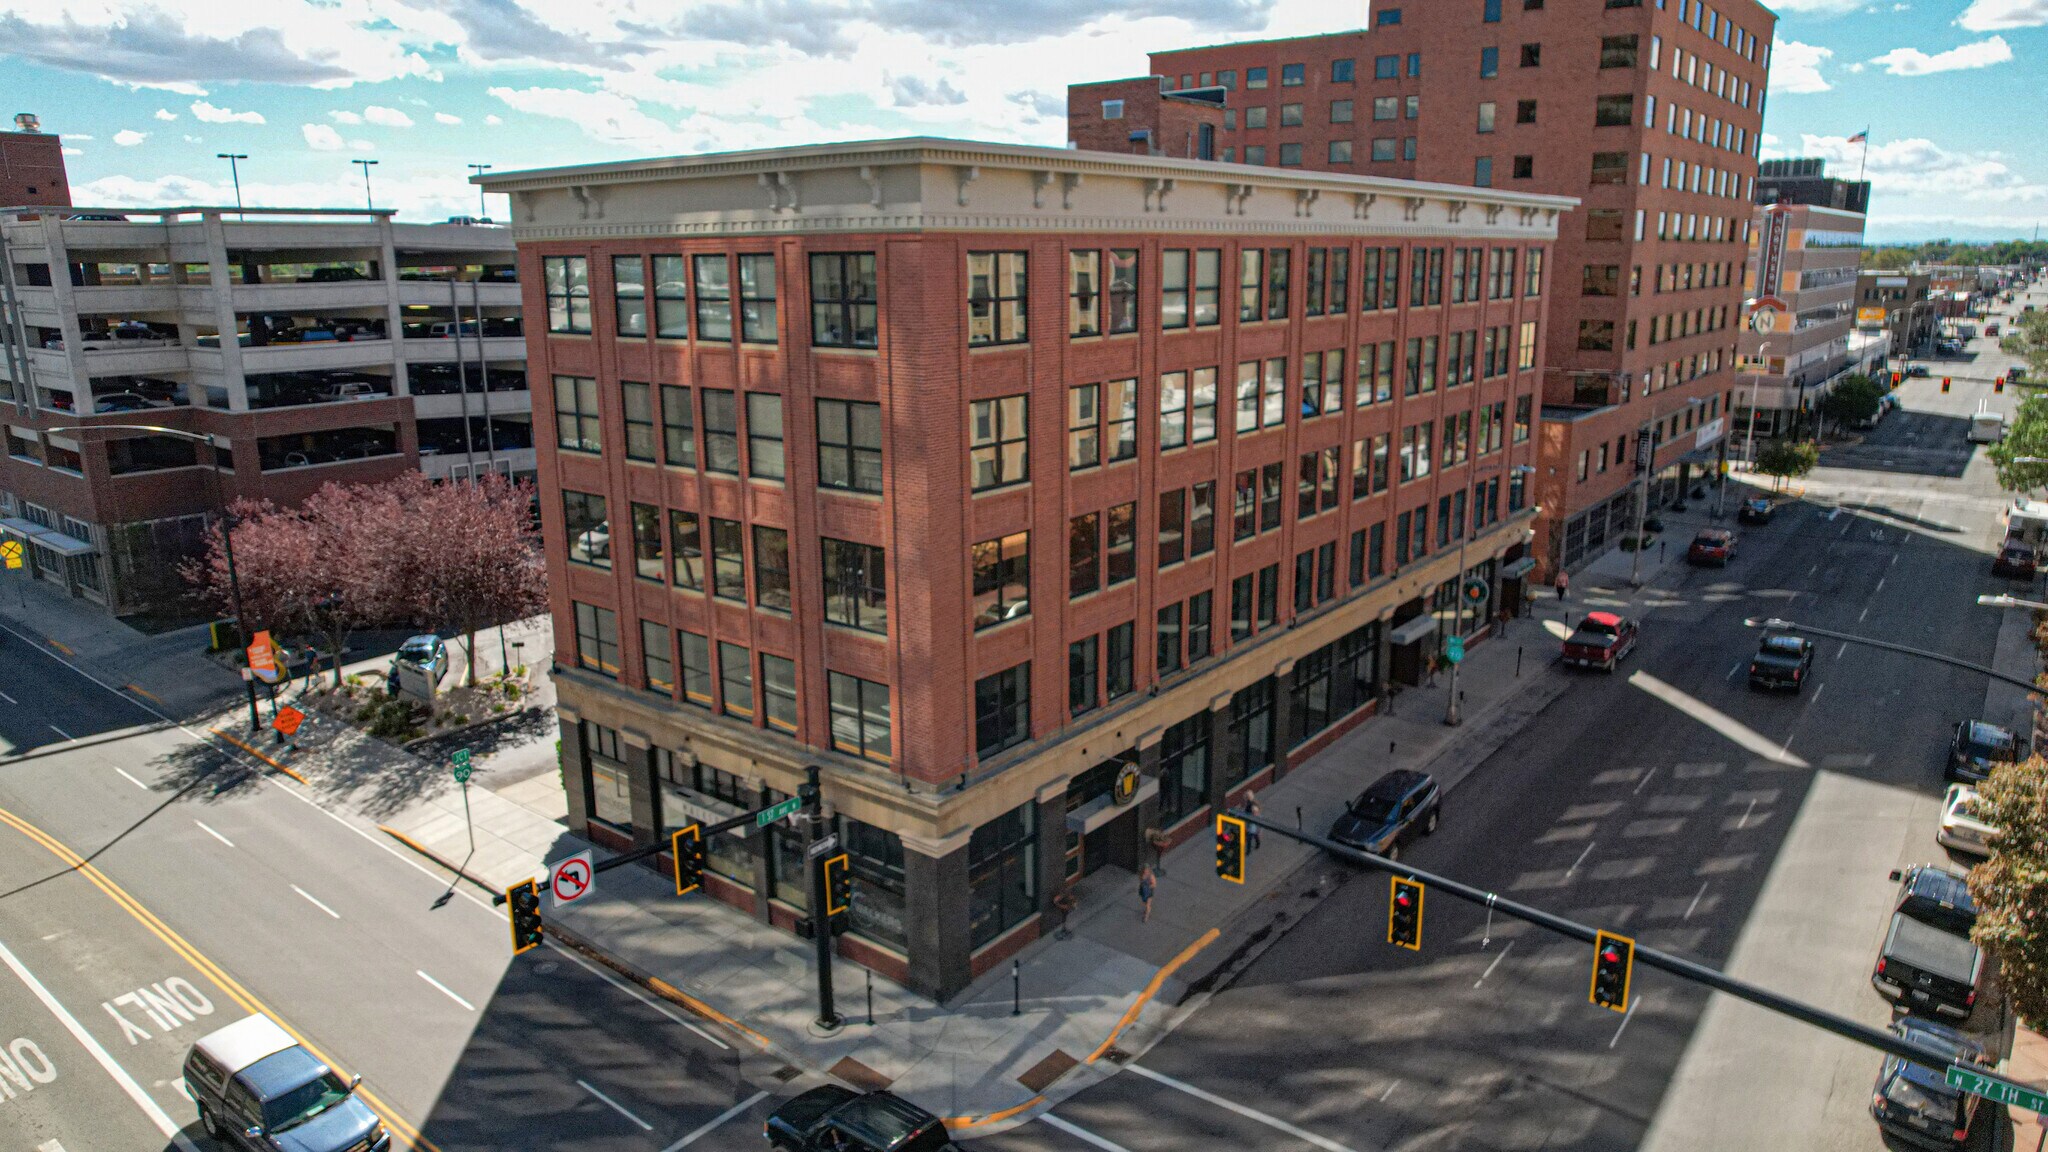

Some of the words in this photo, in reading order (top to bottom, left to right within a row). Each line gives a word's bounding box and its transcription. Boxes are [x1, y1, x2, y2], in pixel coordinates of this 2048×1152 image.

[1767, 216, 1781, 291] NORTHERN
[1760, 313, 1771, 328] N
[456, 769, 470, 780] 90
[101, 976, 215, 1046] ONLY
[0, 1037, 57, 1101] ON
[1955, 1074, 1963, 1088] N
[2030, 1097, 2044, 1111] ST
